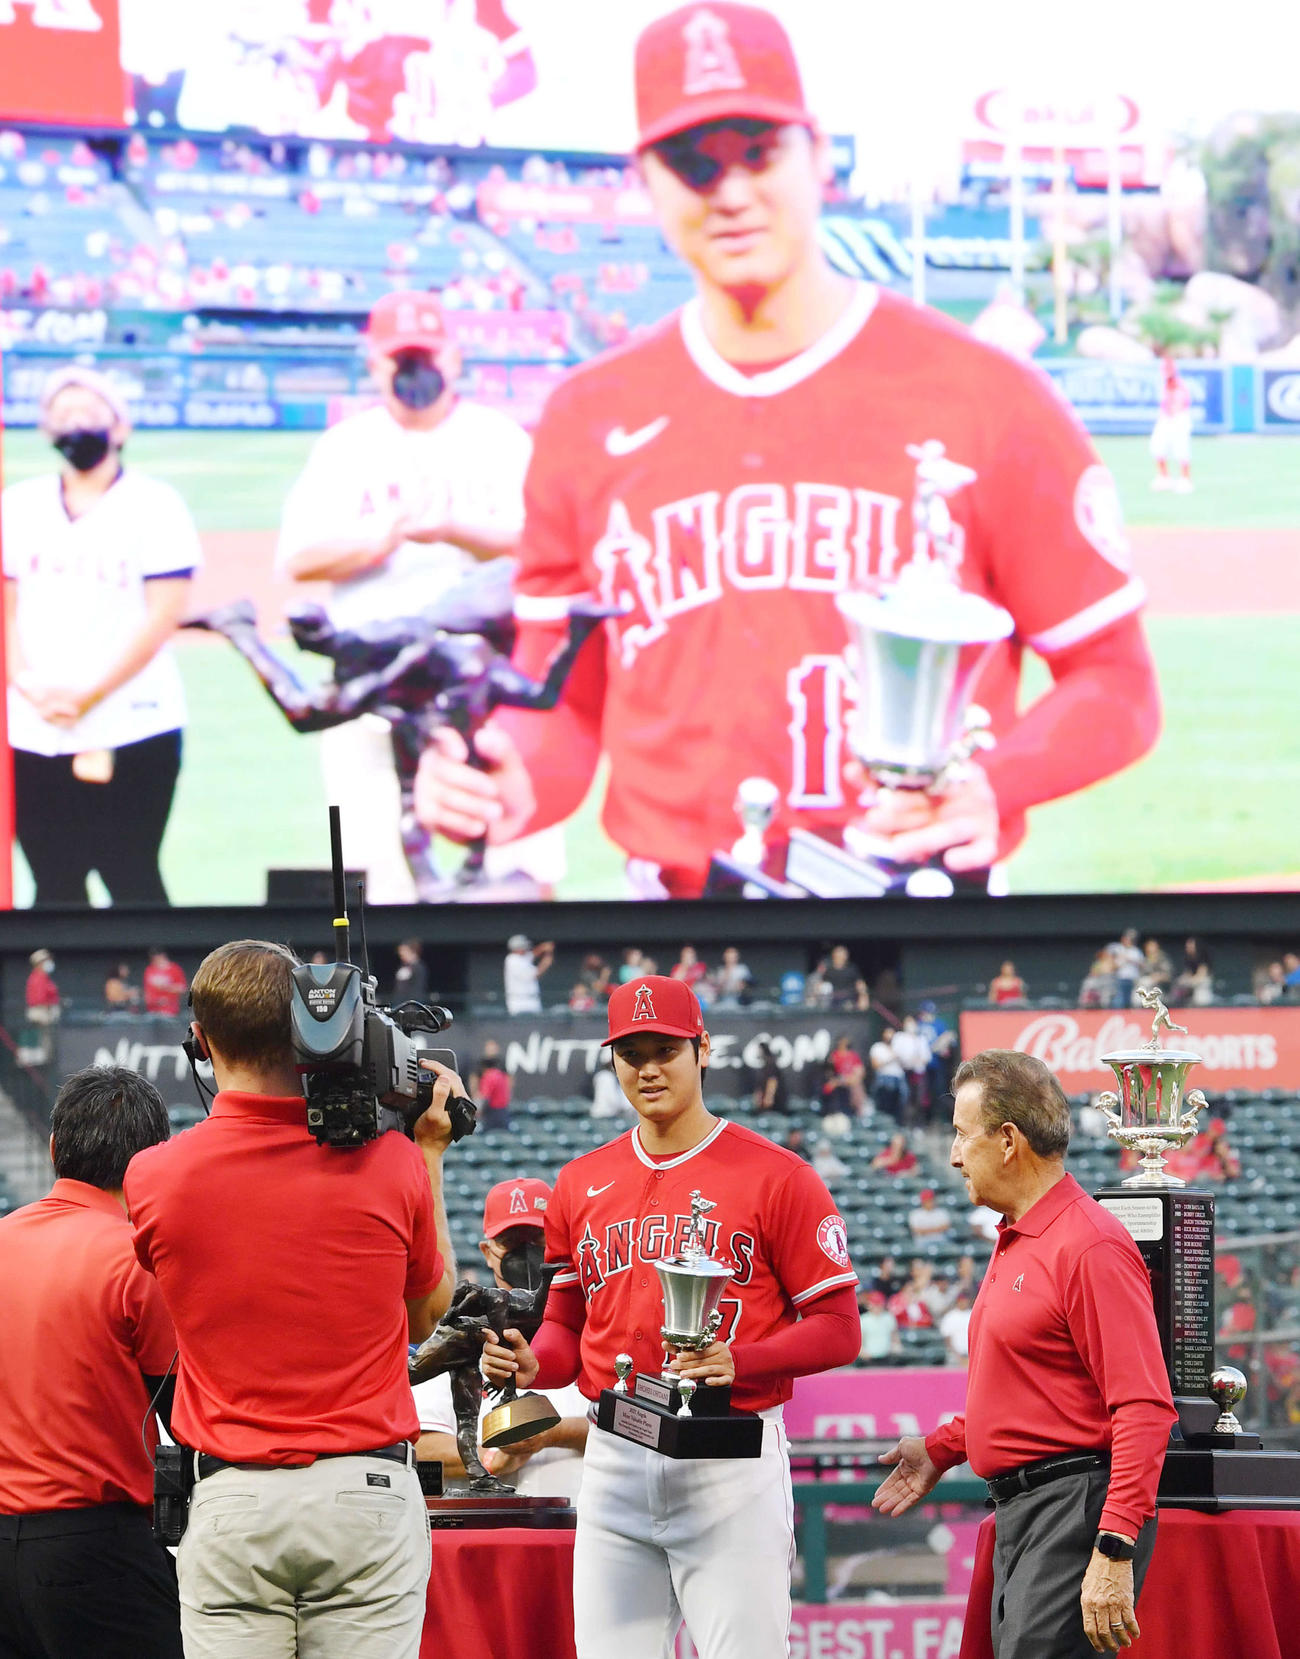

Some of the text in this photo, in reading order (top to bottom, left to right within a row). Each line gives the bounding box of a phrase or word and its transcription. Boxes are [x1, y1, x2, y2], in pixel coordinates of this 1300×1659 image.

[592, 481, 964, 669] ANGEL
[786, 654, 866, 809] 1
[632, 984, 657, 1022] A
[1013, 1014, 1153, 1073] Ball
[510, 1187, 529, 1214] A
[576, 1214, 755, 1306] ANGELS
